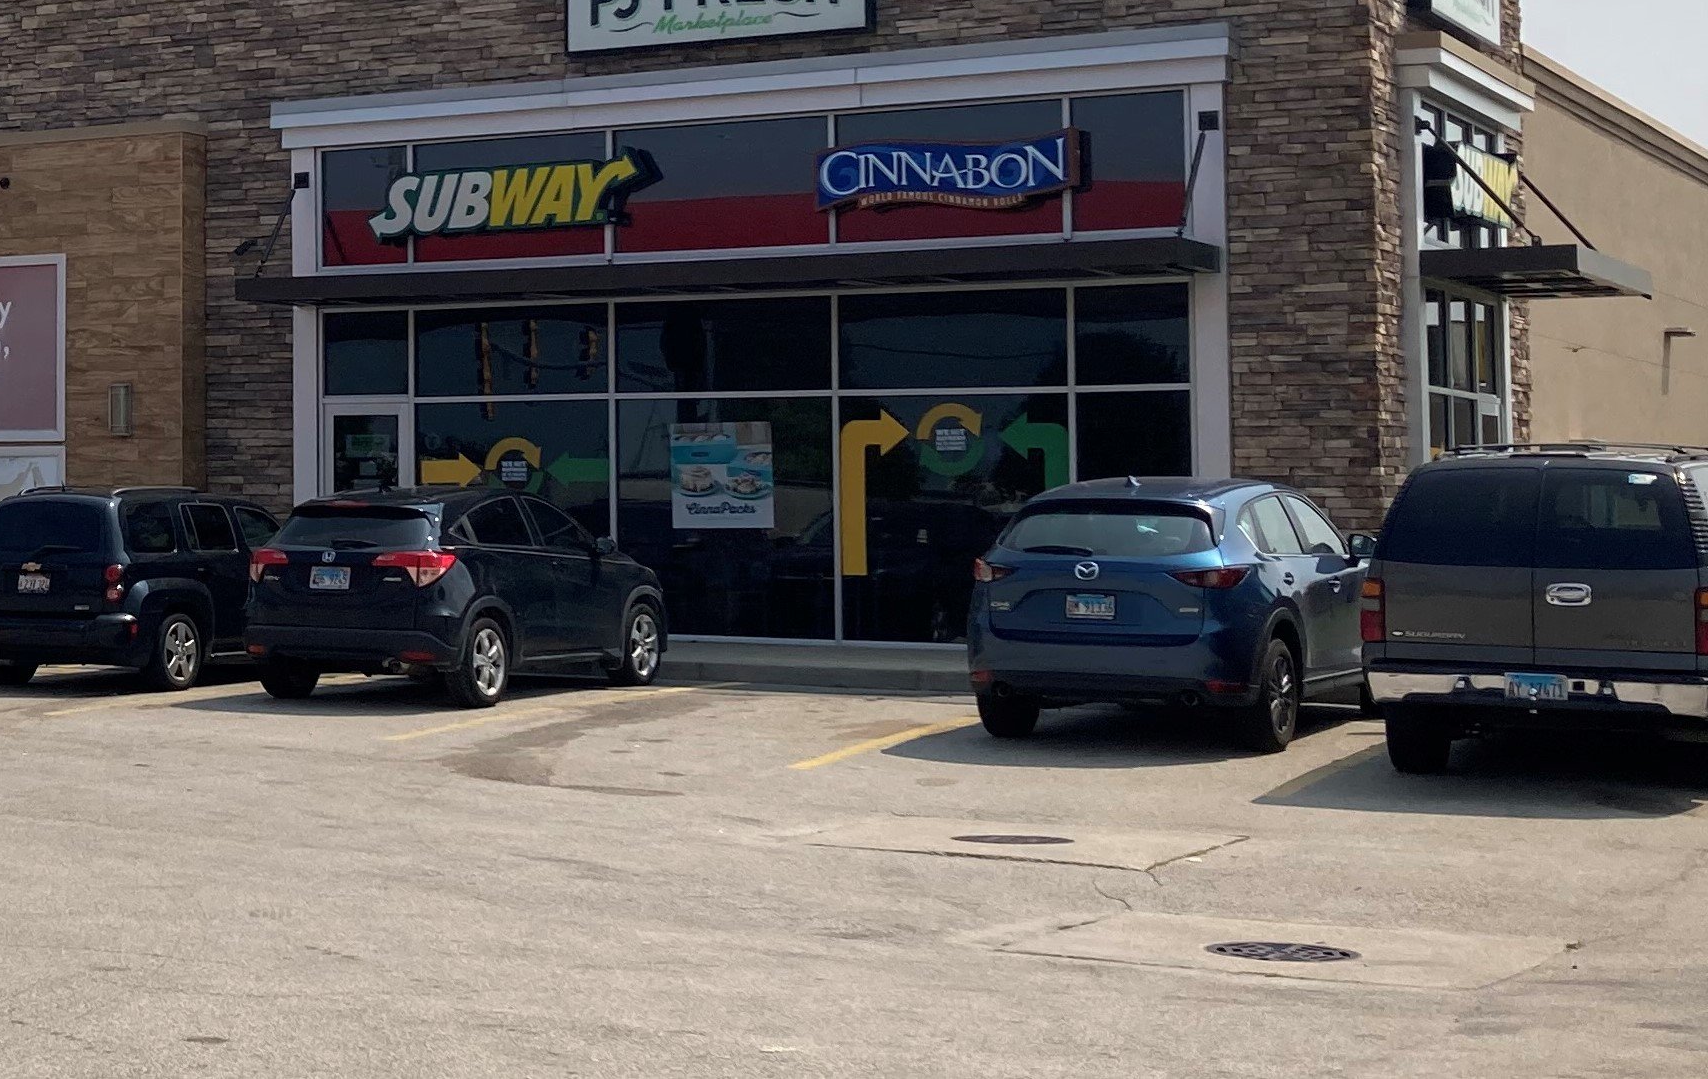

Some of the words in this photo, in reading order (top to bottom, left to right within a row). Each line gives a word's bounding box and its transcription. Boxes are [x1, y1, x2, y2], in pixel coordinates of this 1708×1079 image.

[652, 9, 774, 34] Marketplace
[820, 137, 1065, 196] CINNABON
[368, 155, 638, 237] SUBWAY
[861, 192, 892, 206] WORLD
[896, 190, 934, 202] FAMOUS
[937, 192, 988, 208] CINNAMON
